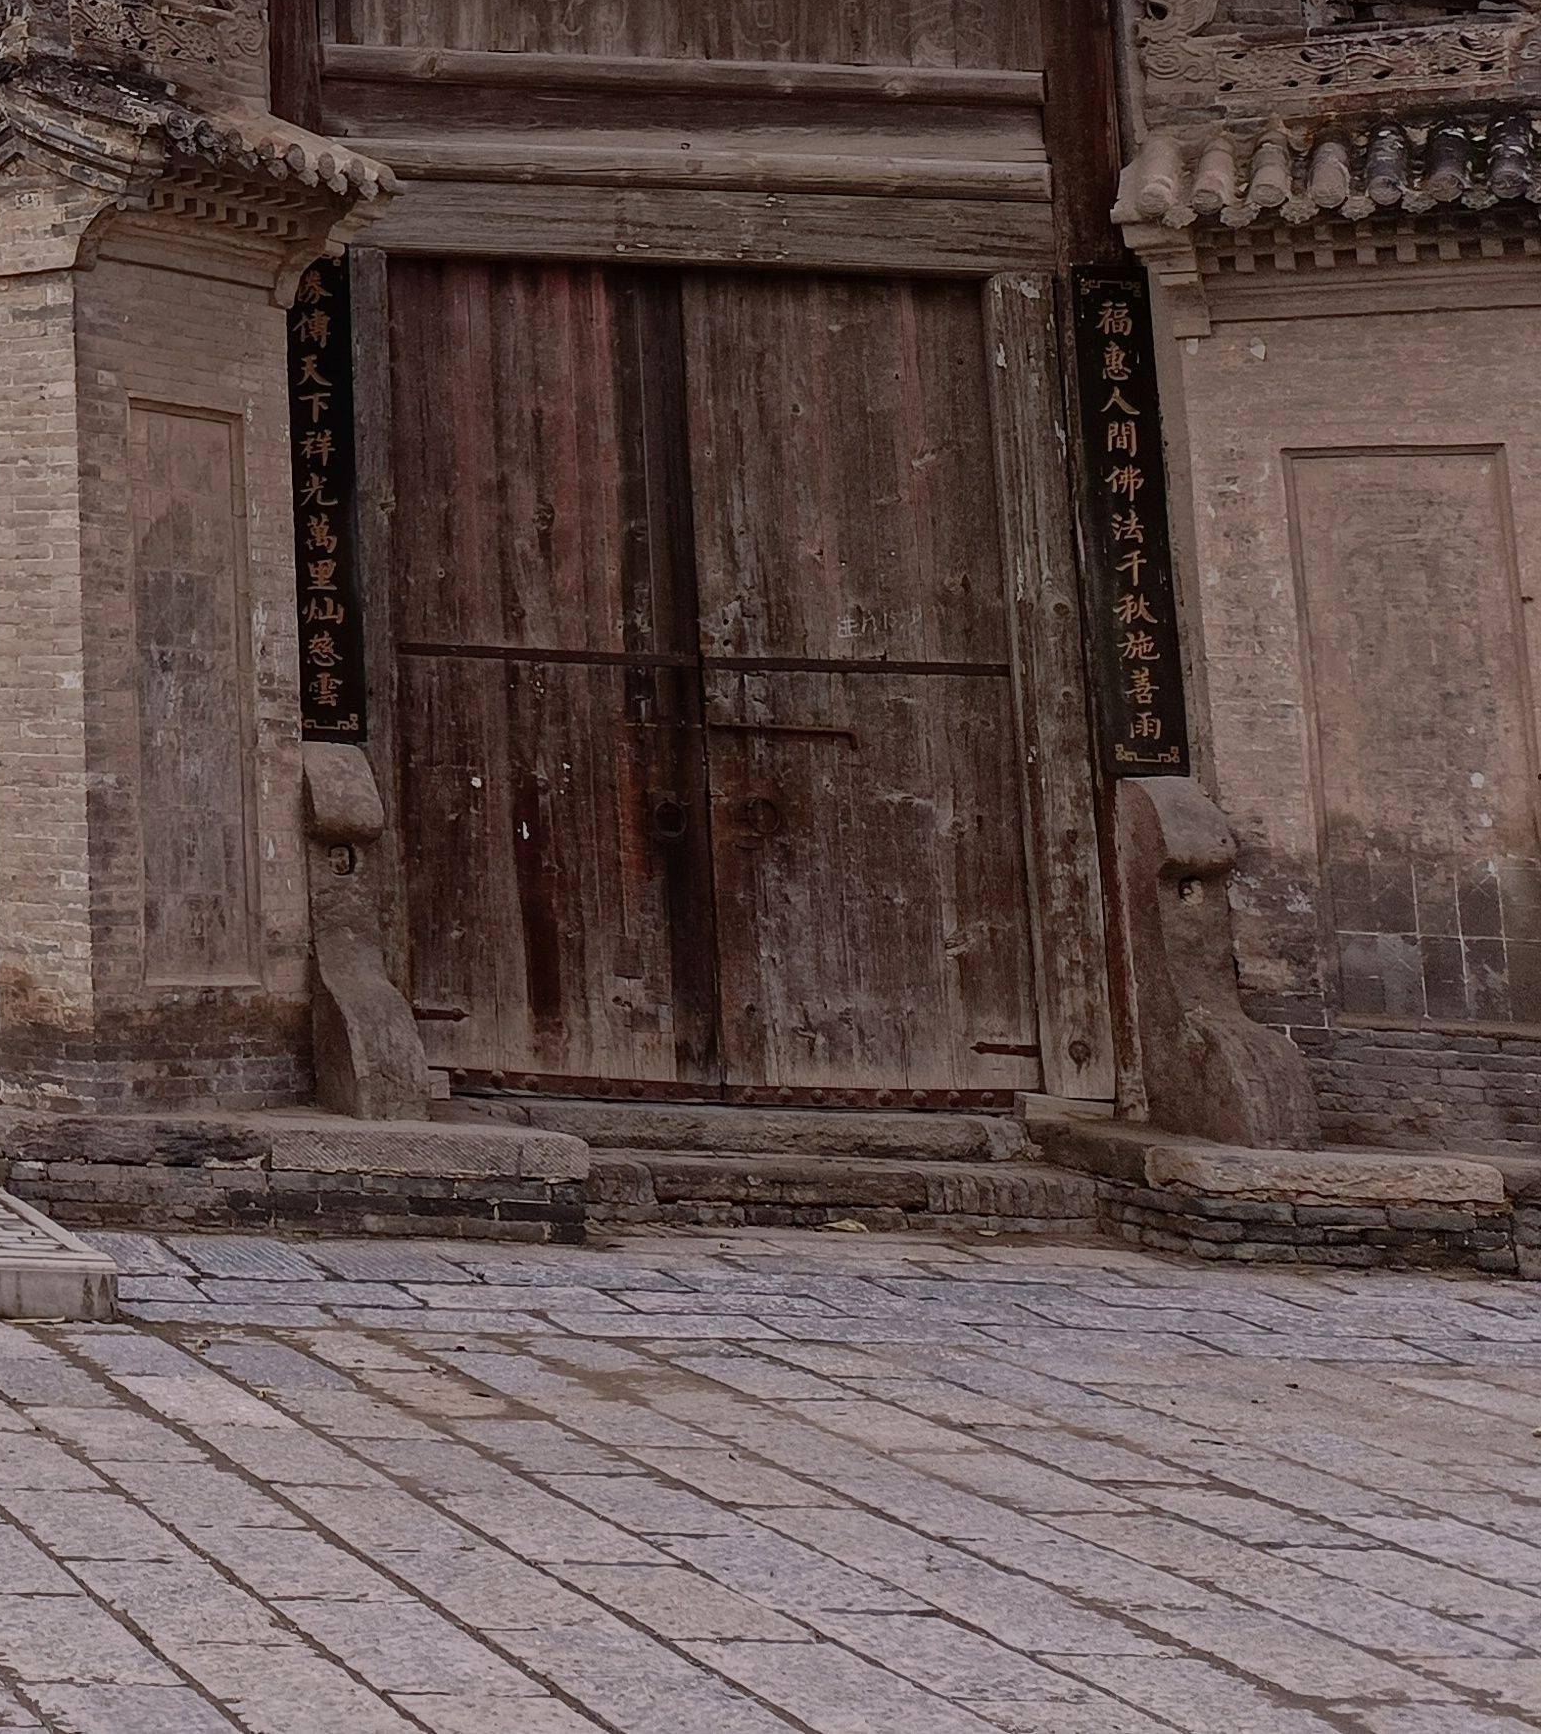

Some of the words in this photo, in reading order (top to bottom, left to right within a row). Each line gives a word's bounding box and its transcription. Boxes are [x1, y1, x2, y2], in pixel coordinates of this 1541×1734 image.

[1096, 301, 1162, 740] 福惠人間佛法千秋施善雨
